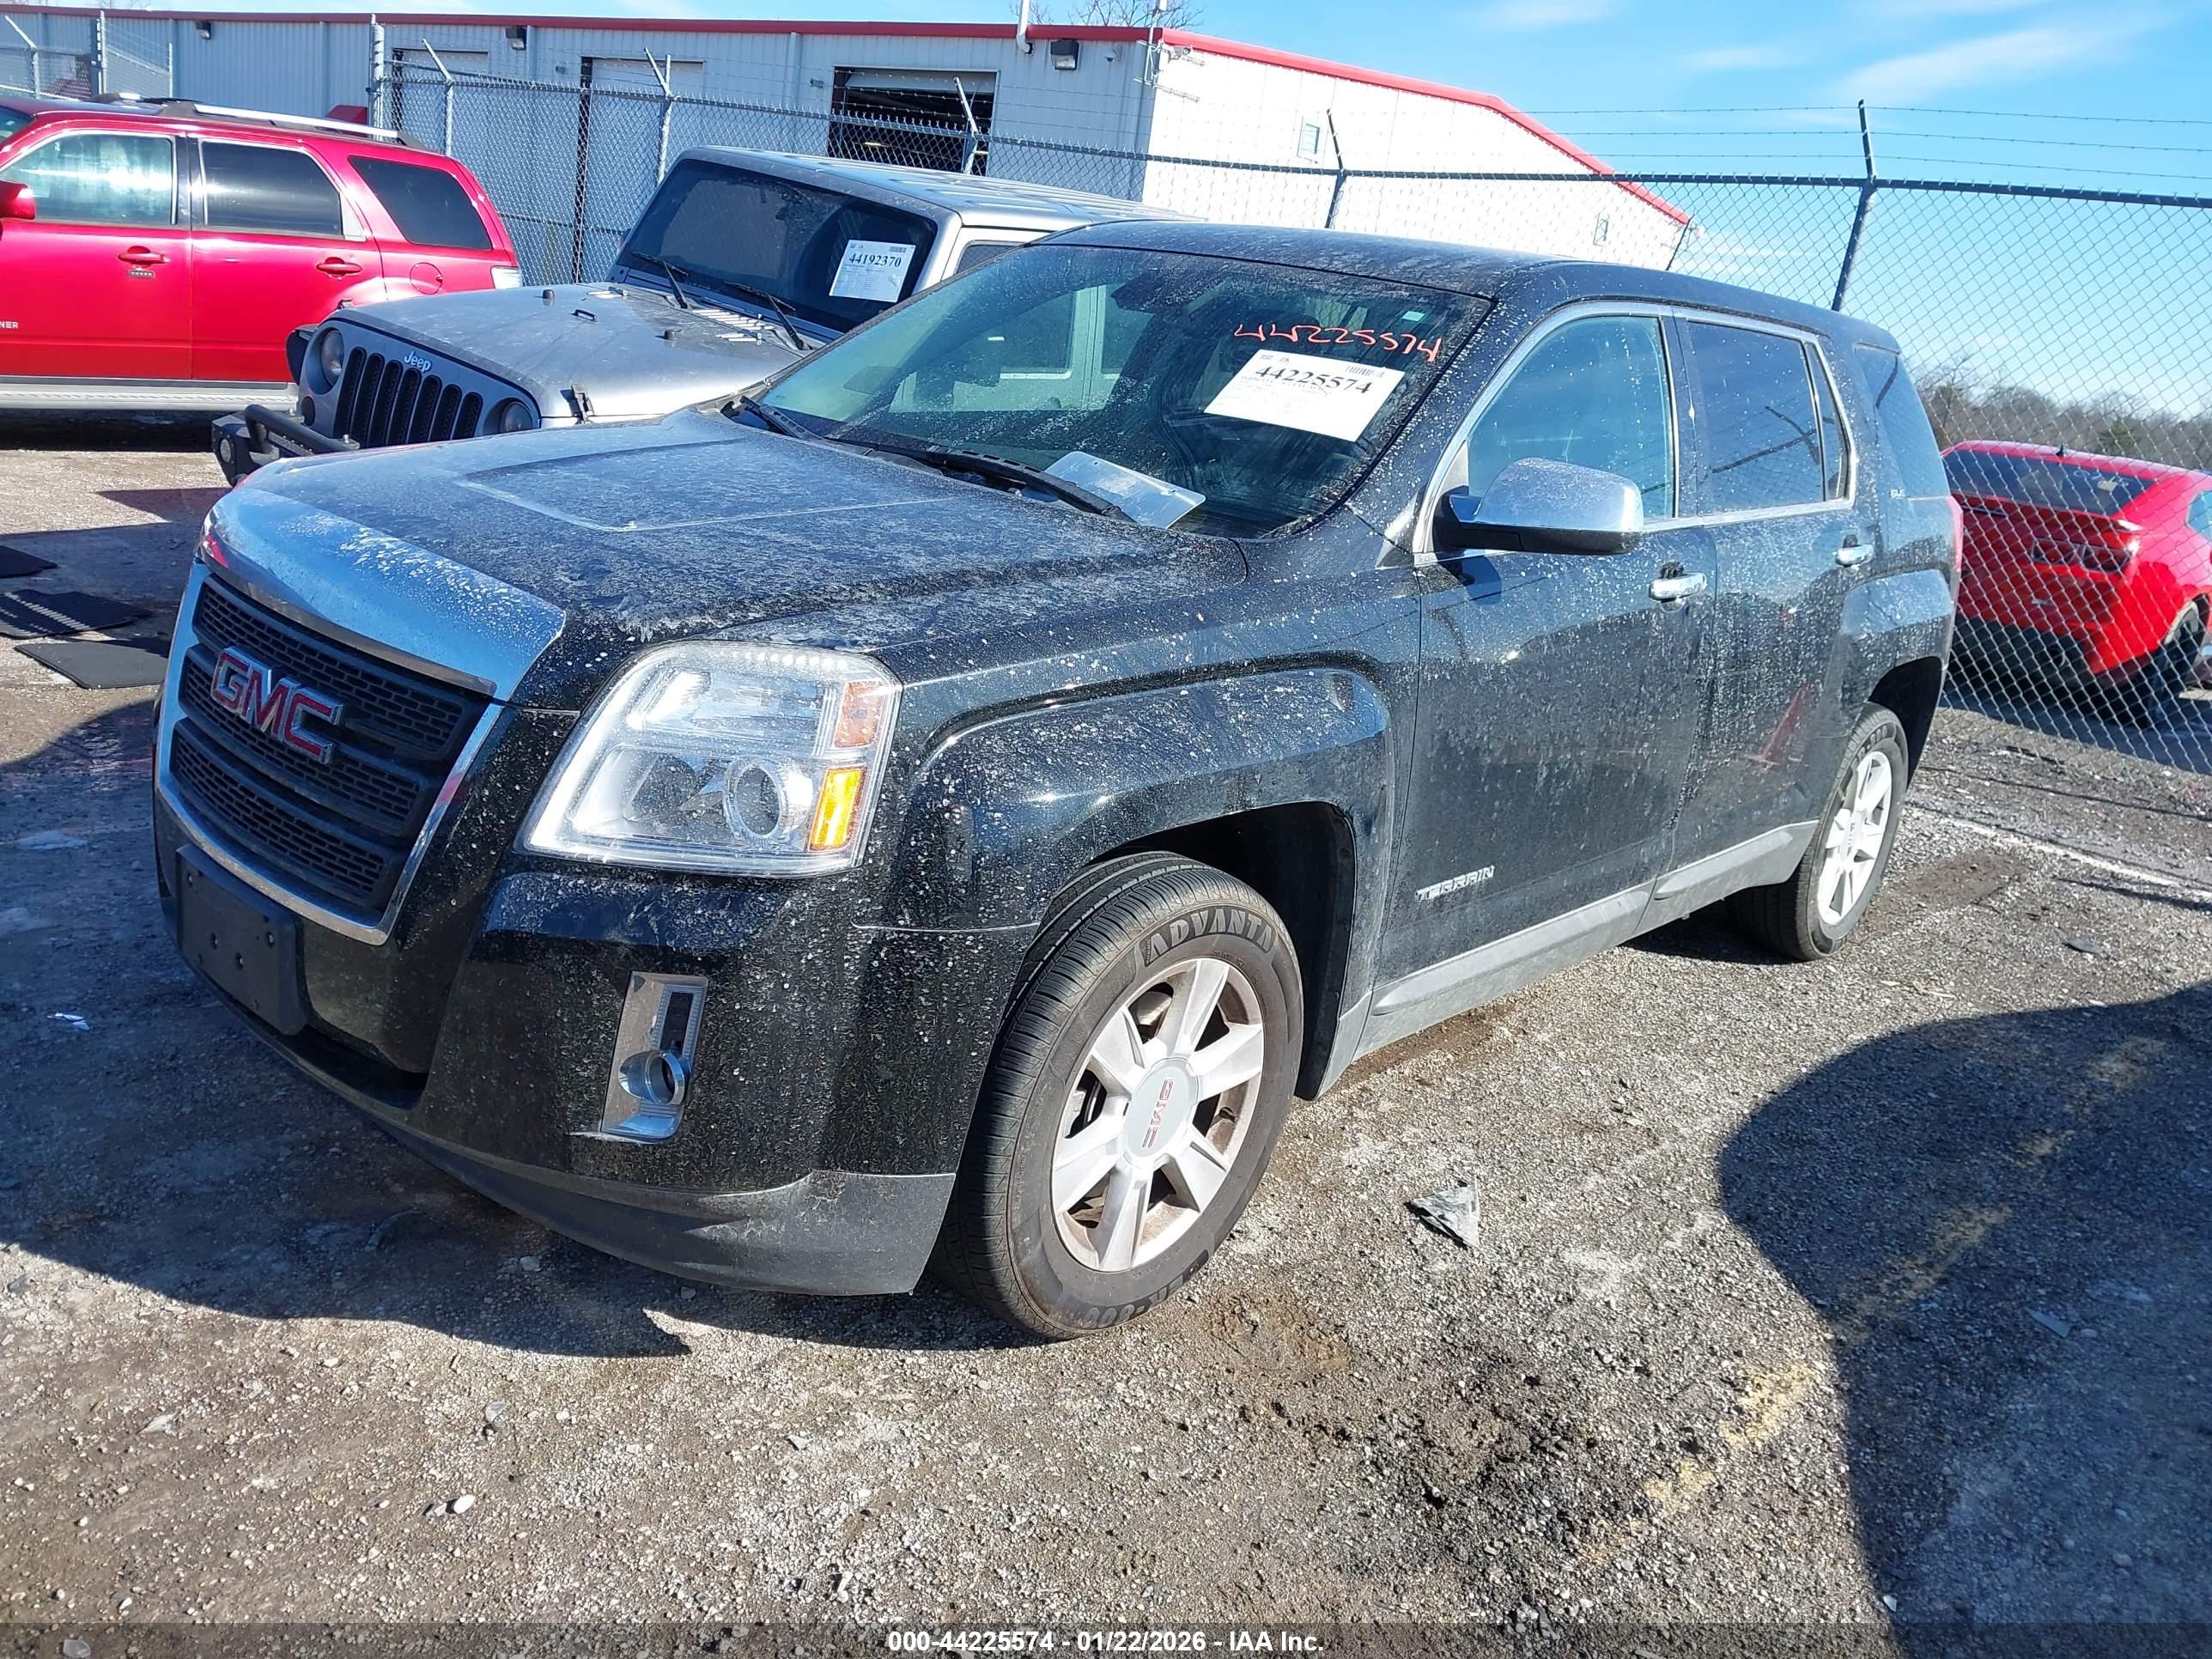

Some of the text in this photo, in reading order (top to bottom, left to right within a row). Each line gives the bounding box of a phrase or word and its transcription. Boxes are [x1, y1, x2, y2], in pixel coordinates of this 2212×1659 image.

[848, 252, 902, 268] 44192370
[404, 350, 432, 372] Jeep
[1234, 324, 1443, 362] 44225574
[1255, 366, 1373, 394] 44225574
[210, 646, 343, 764] GMC
[1414, 864, 1495, 902] TERRAIN
[1147, 908, 1274, 963] ADVANTA
[1141, 1078, 1175, 1148] GMC
